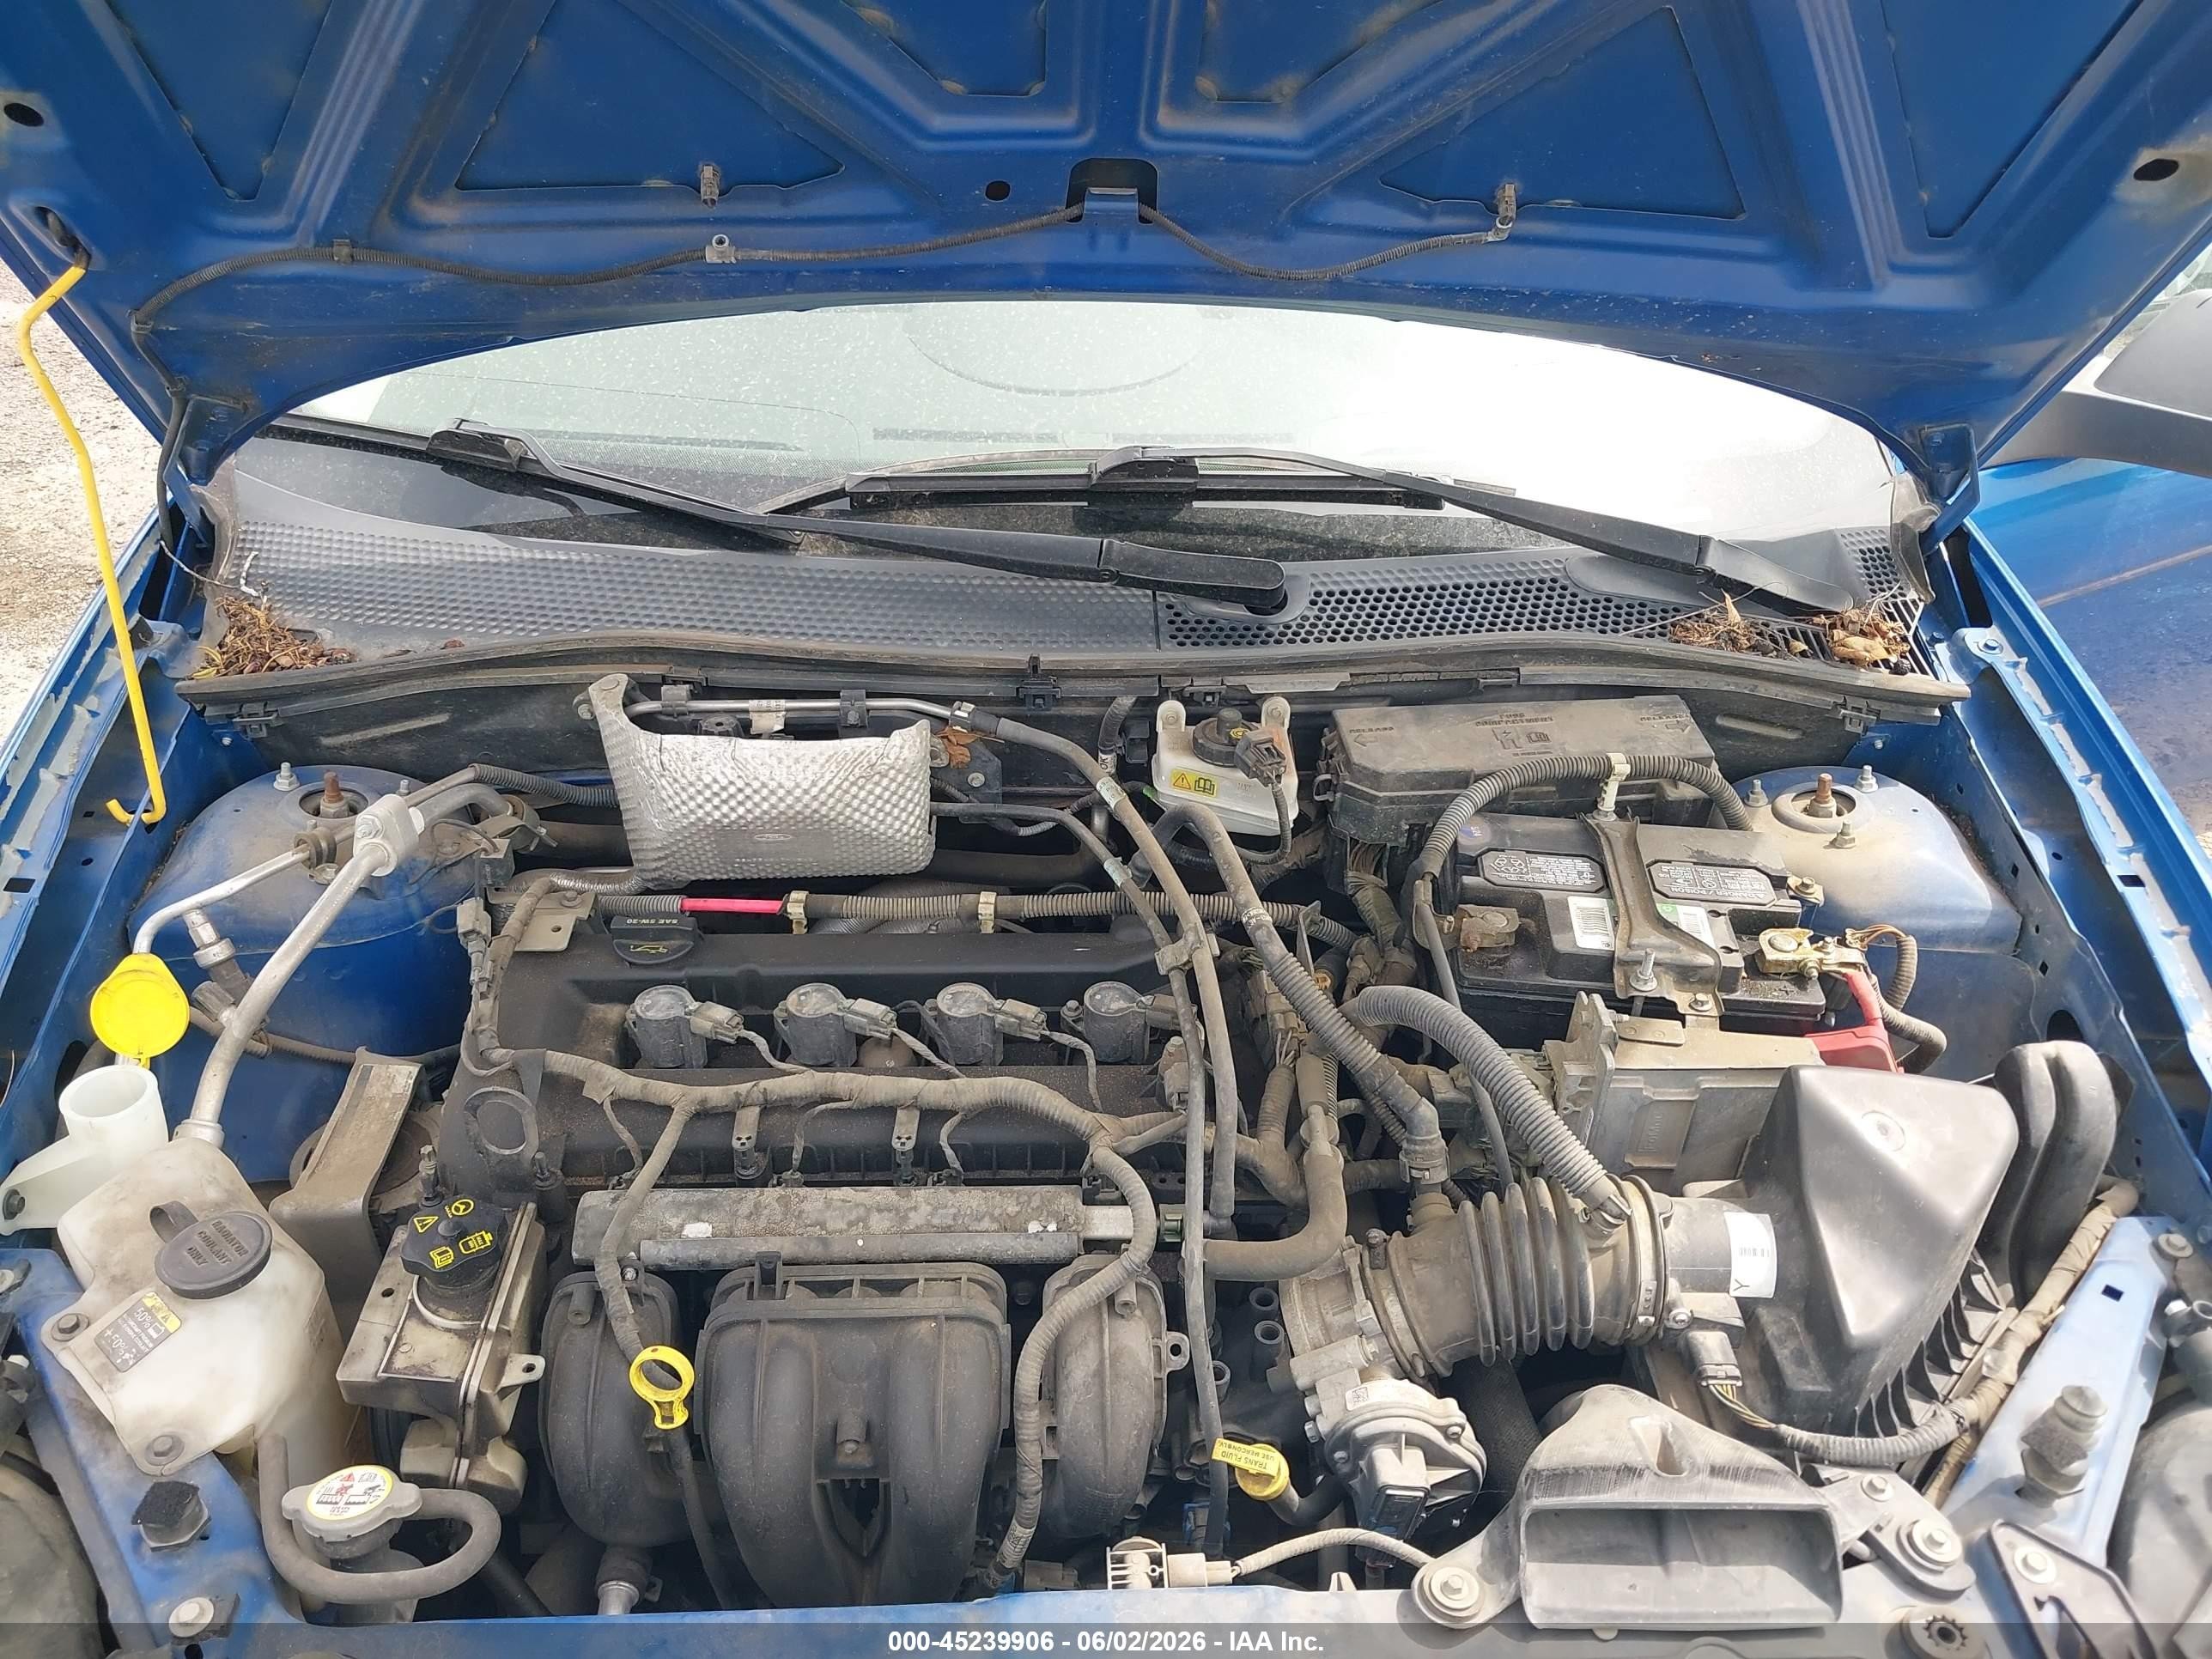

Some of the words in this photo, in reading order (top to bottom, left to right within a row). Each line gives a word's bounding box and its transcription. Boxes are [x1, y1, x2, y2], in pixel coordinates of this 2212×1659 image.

[1669, 886, 1707, 896] POISON
[1716, 890, 1759, 899] DANGER
[211, 1219, 249, 1257] RADIATOR
[197, 1230, 233, 1264] COOLANT
[185, 1245, 209, 1267] ONLY
[134, 1307, 154, 1329] 50%
[1221, 1450, 1243, 1462] FLUID
[1243, 1456, 1267, 1470] TRANS
[1261, 1452, 1275, 1462] USE
